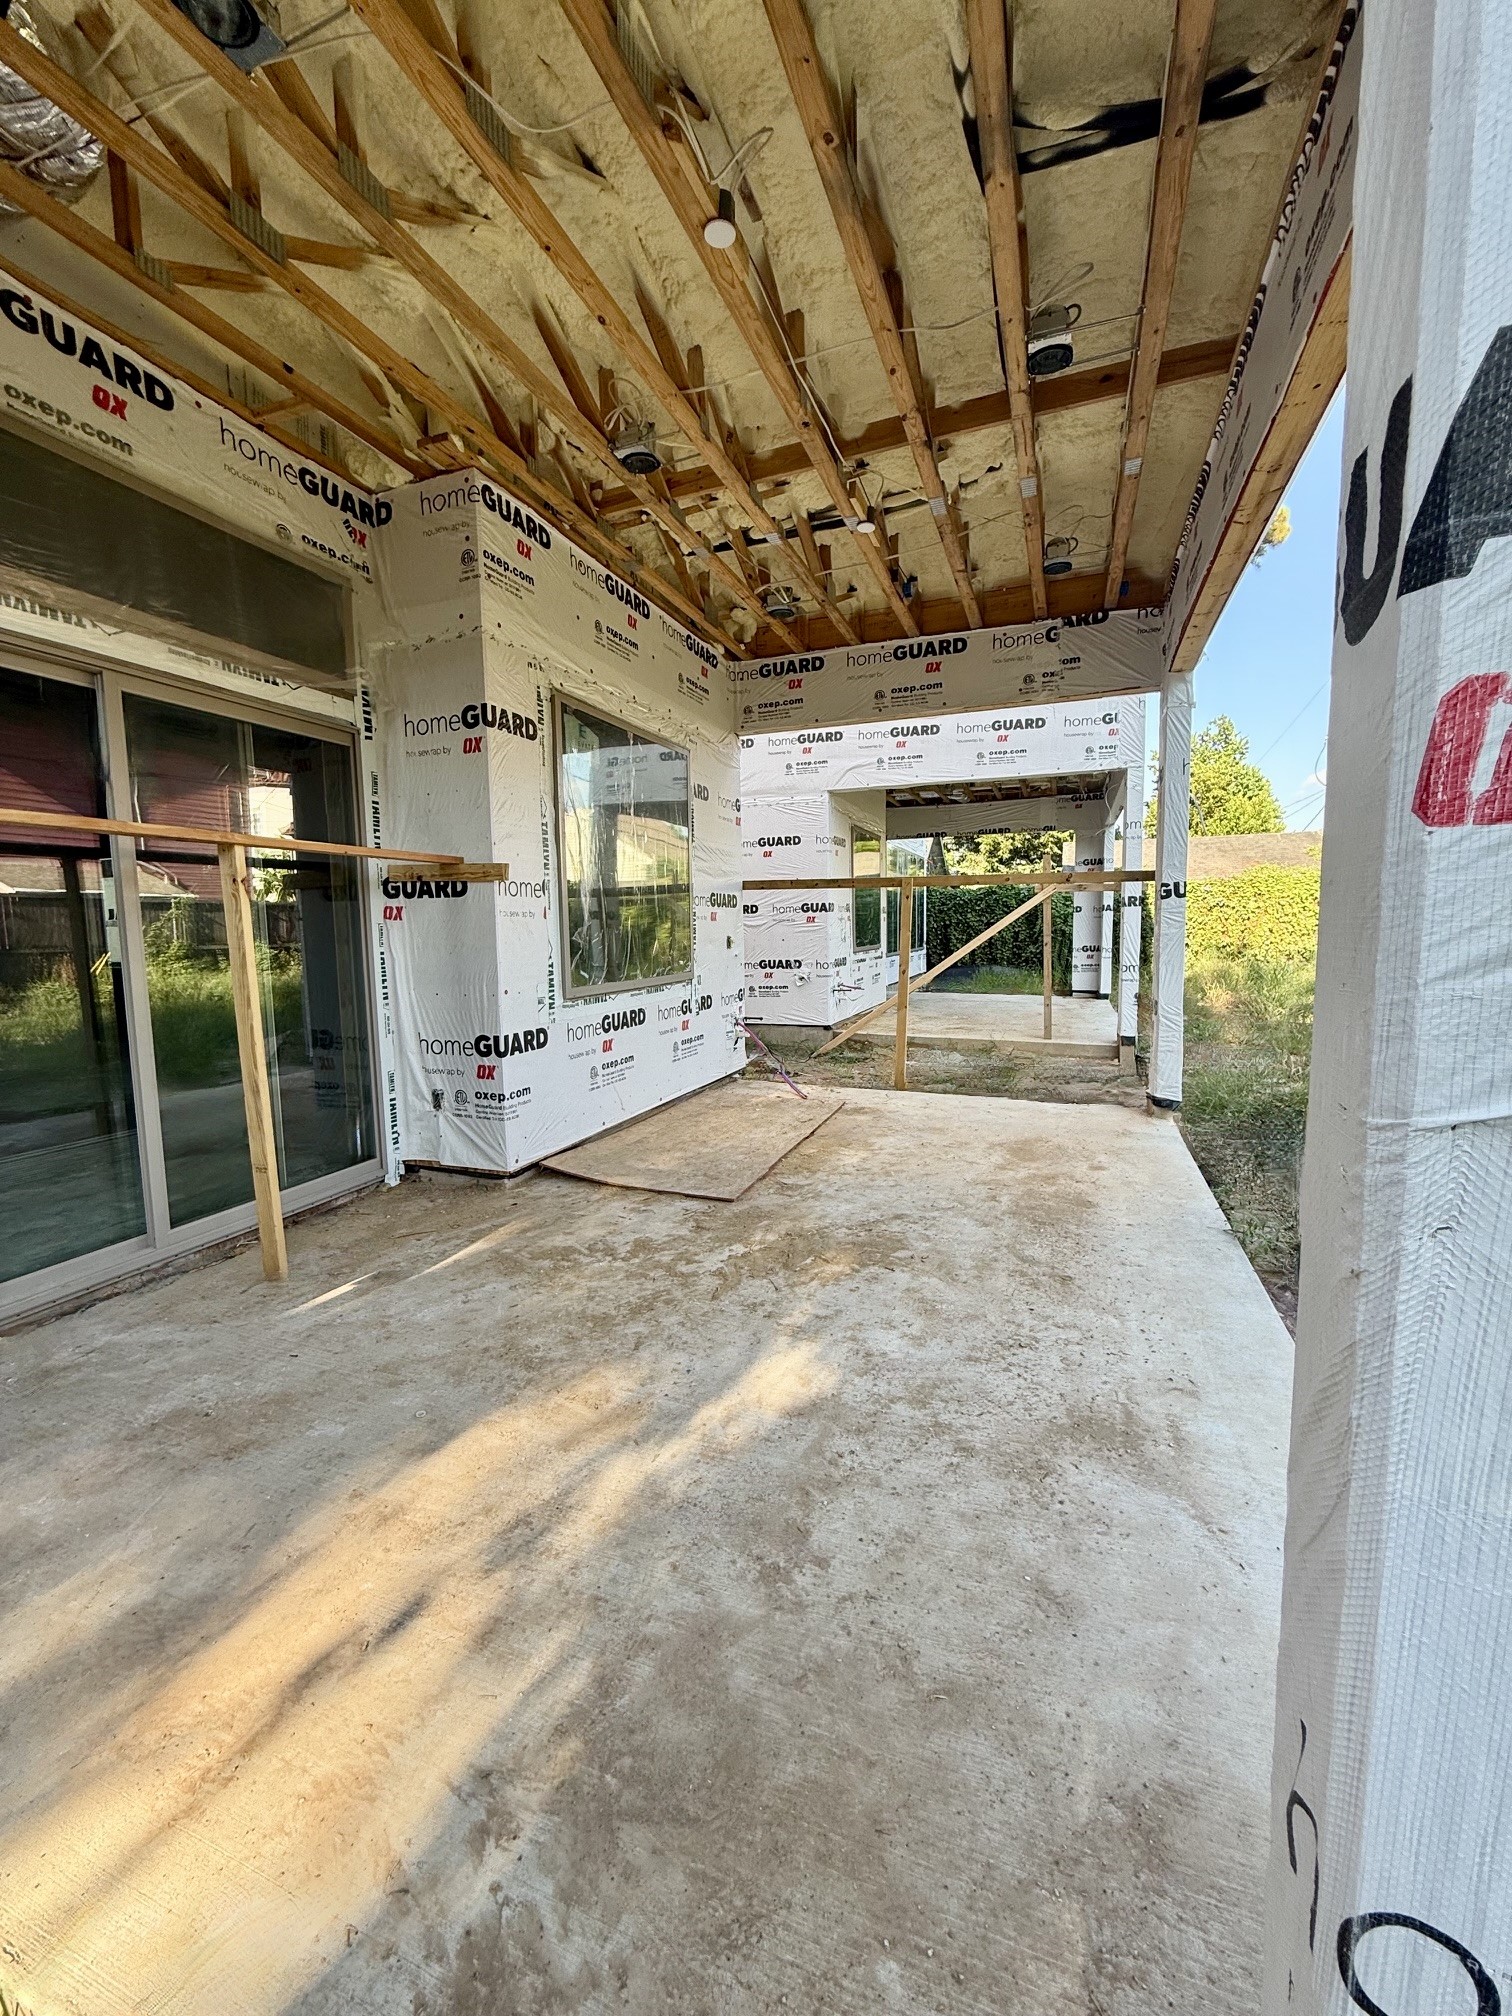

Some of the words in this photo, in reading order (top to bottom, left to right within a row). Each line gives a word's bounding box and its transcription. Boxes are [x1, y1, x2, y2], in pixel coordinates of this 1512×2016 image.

[0, 288, 175, 412] GUARD
[92, 384, 128, 422] OX
[3, 384, 134, 457] oxep.com
[219, 416, 393, 528] homeGUARD
[420, 484, 551, 549] homeGUARD
[517, 539, 532, 560] OX
[483, 550, 535, 586] oxep.com
[570, 547, 650, 620] homeGUARD
[628, 613, 637, 631] OX
[606, 625, 638, 651] oxep.com
[661, 617, 719, 669] homeGUARD
[846, 637, 968, 667] homeGUARD
[726, 656, 825, 681] homeGUARD
[925, 661, 942, 673] OX
[686, 676, 710, 695] oxep.com
[788, 678, 803, 690] OX
[891, 682, 943, 694] oxep.com
[758, 697, 804, 710] oxep.com
[404, 703, 537, 741] homeGUARD
[957, 718, 1046, 734] homeGUARD
[768, 731, 843, 746] homeGUARD
[858, 725, 940, 740] homeGUARD
[442, 746, 452, 756] by
[463, 736, 483, 754] OX
[989, 748, 1027, 756] oxep.com
[383, 905, 404, 921] OX
[567, 1008, 645, 1042] homeGUARD
[418, 1027, 548, 1058] homeGUARD
[602, 1038, 614, 1053] OX
[602, 1055, 634, 1070] oxep.com
[457, 1067, 465, 1077] by
[477, 1065, 496, 1080] OX
[475, 1086, 531, 1104] oxep.com
